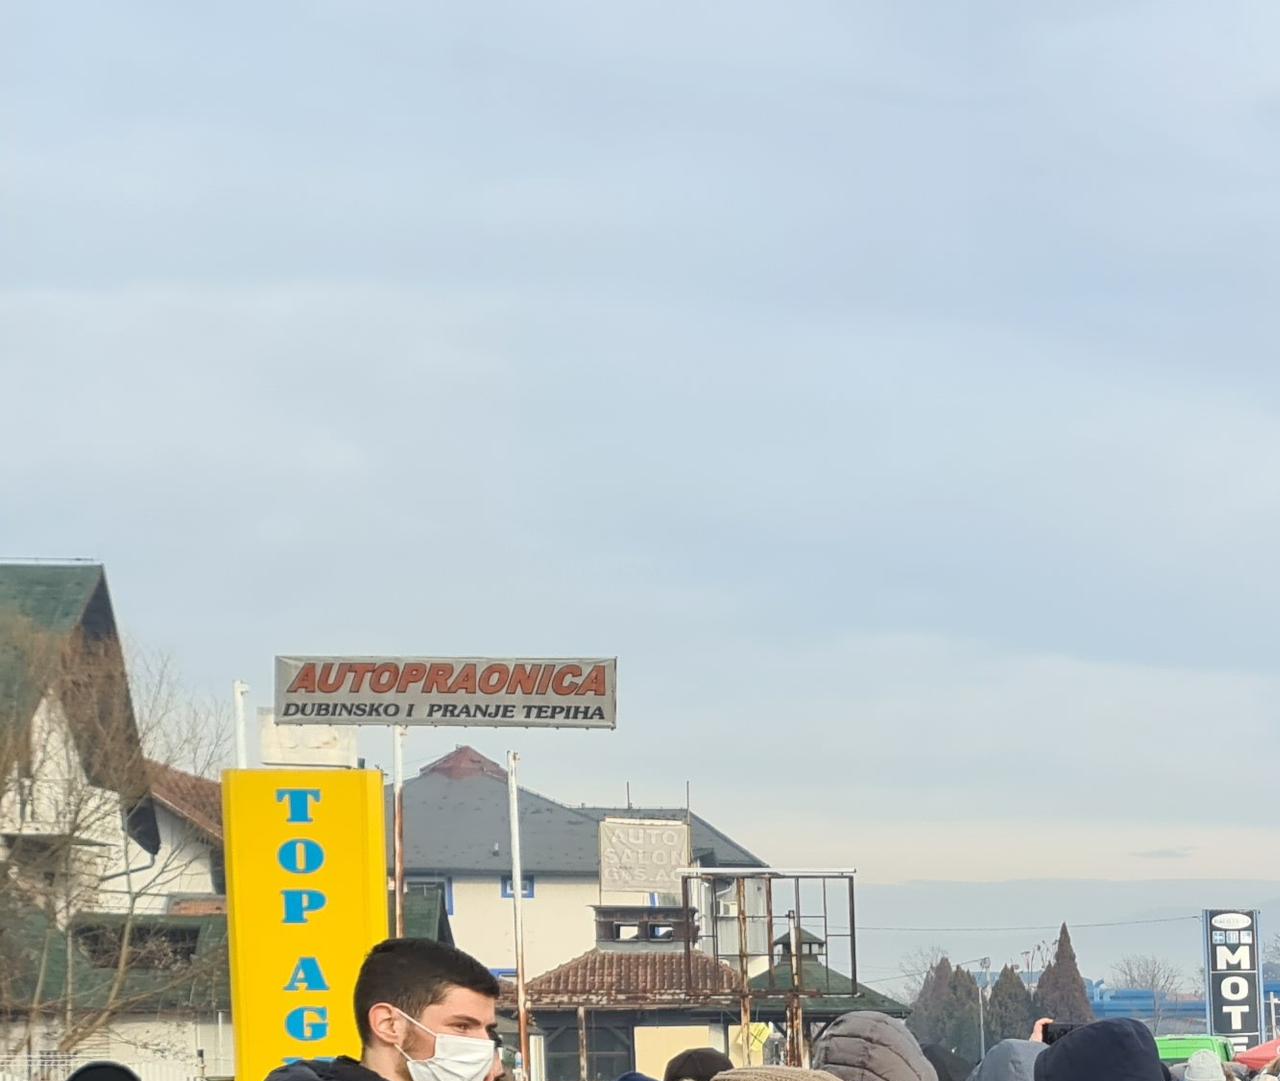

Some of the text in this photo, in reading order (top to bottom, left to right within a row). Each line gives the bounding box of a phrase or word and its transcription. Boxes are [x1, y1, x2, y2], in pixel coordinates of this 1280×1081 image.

[286, 662, 607, 697] AUTOPRAONICA
[282, 702, 605, 720] DUBINSKO I PRANJE TEPIHA
[611, 828, 677, 845] AUTO
[275, 788, 326, 923] TOP
[604, 848, 685, 865] SALON
[282, 956, 338, 1064] AG
